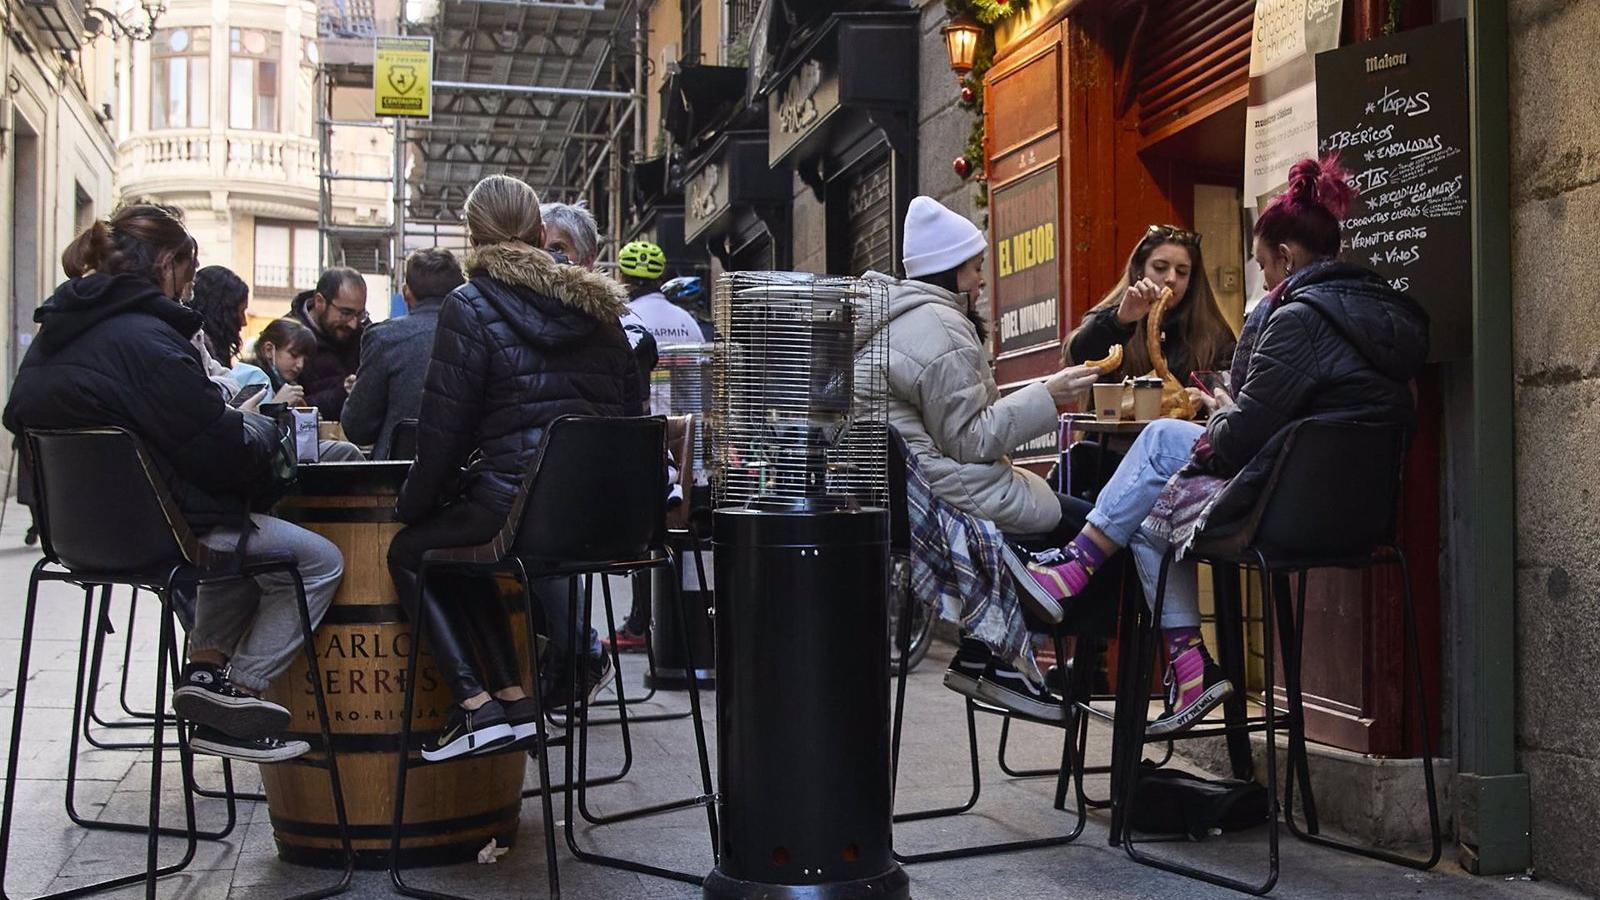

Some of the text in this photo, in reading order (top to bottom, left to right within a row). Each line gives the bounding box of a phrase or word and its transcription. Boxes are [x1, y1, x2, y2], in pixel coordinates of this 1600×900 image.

[1365, 53, 1407, 73] Mahou
[1376, 135, 1442, 160] ENSALADAS
[1411, 175, 1462, 203] CALAMARES
[1346, 212, 1389, 229] CROQUETAS
[998, 222, 1055, 277] EL MEJOR
[1351, 231, 1386, 250] VERMUT
[1383, 231, 1394, 243] DE
[1019, 298, 1056, 335] MUNDO!
[306, 710, 359, 721] HRO
